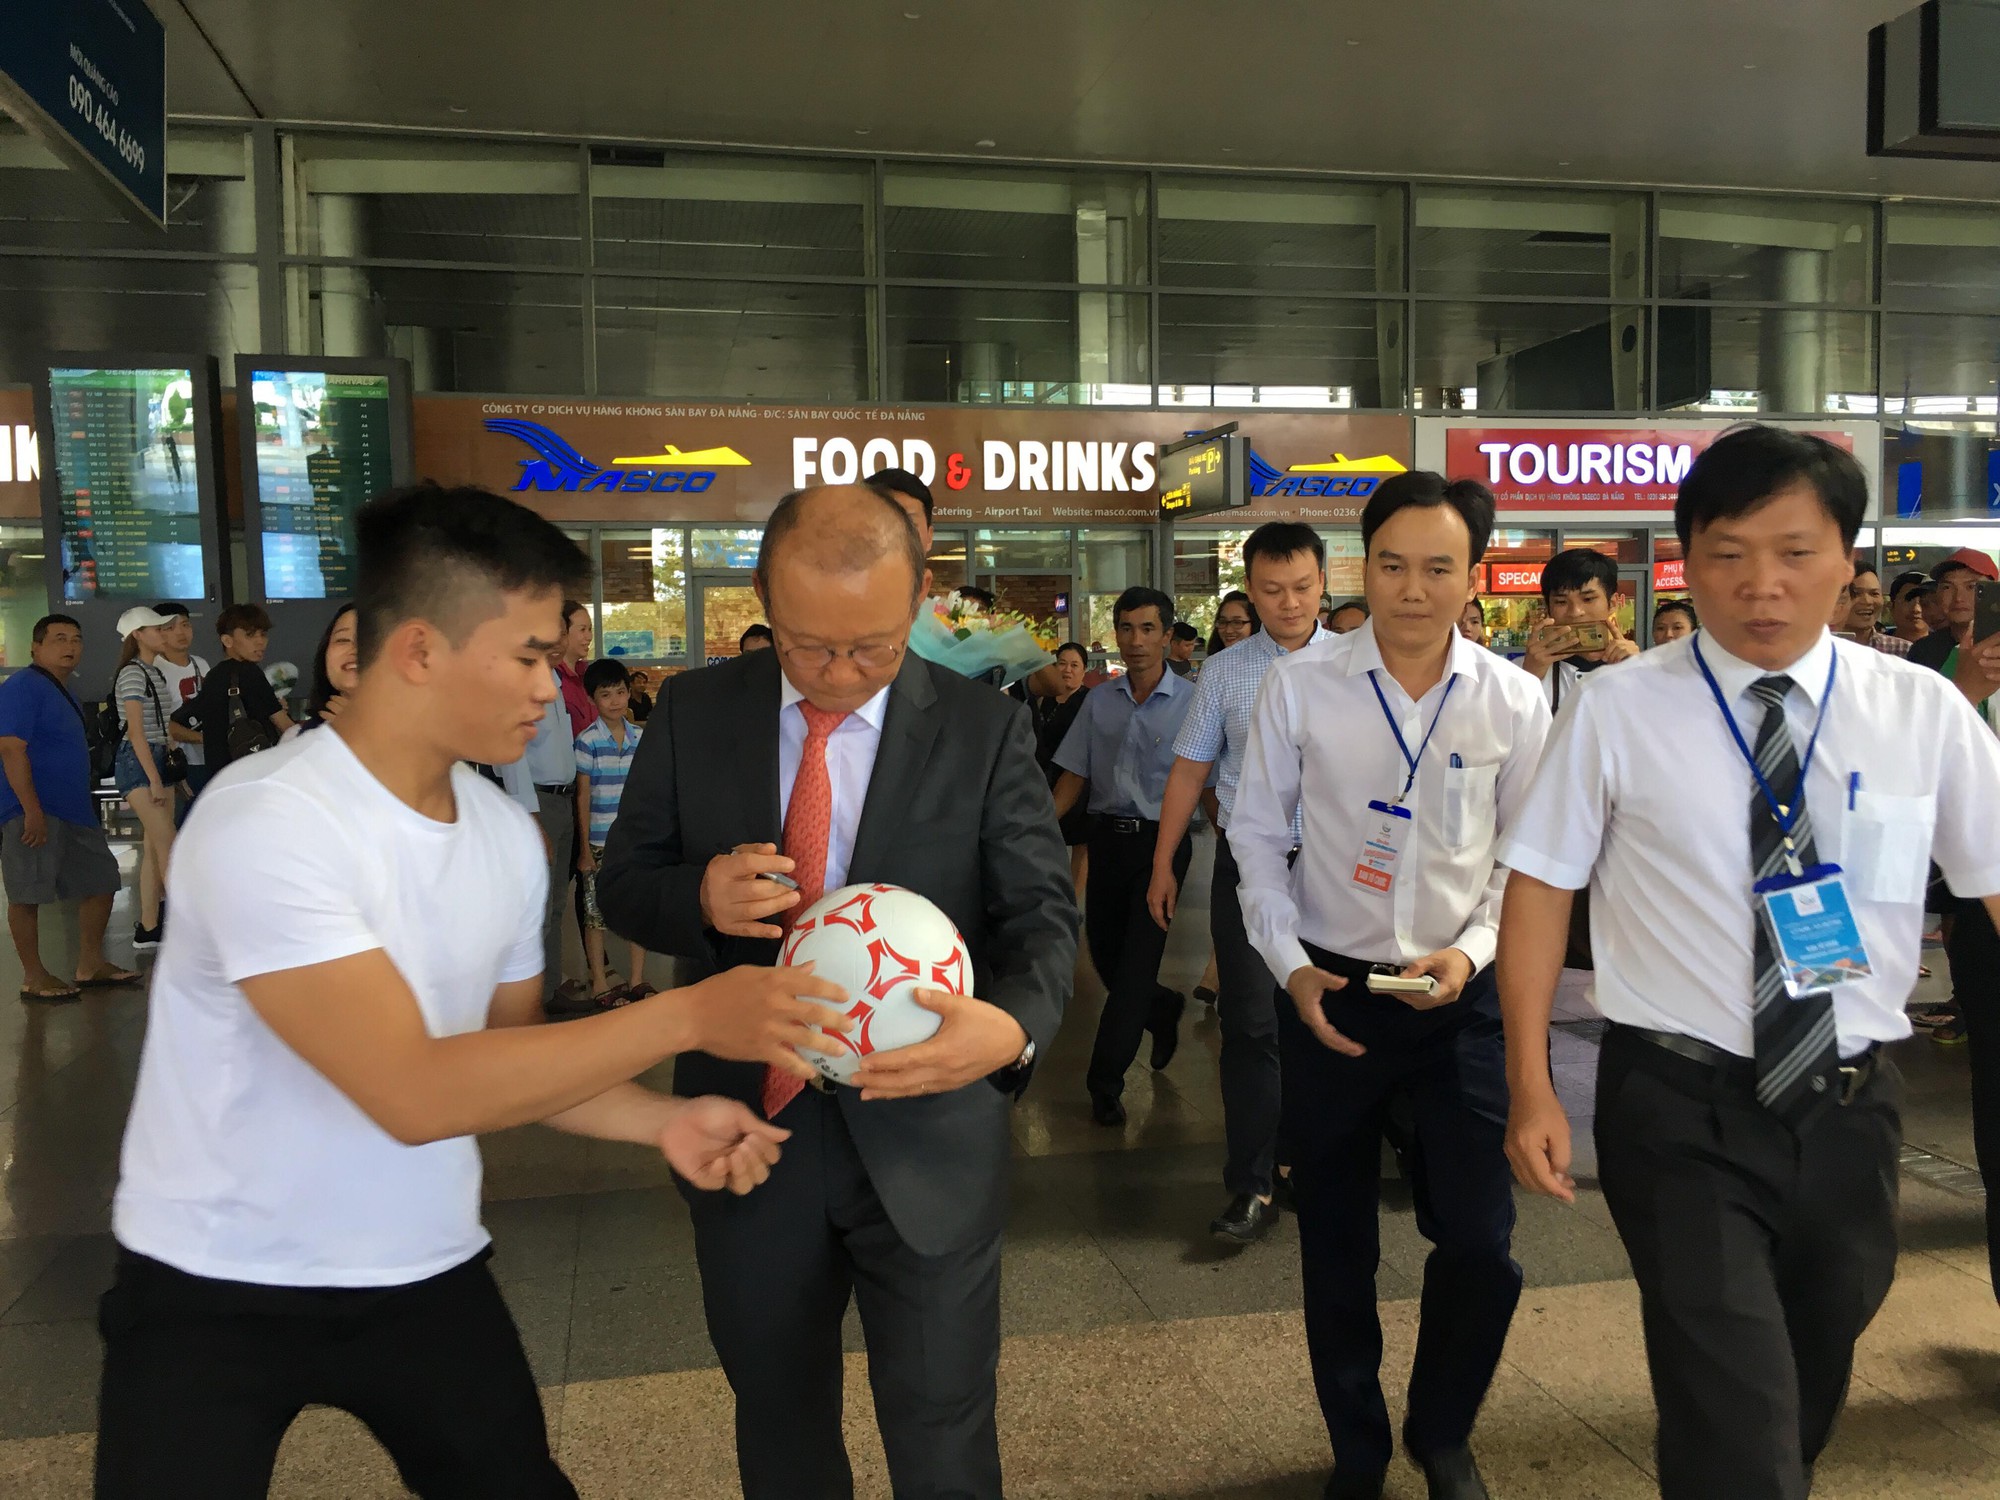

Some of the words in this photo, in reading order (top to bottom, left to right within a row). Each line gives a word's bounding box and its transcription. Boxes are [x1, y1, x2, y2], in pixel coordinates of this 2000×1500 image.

[69, 74, 92, 123] 090
[95, 103, 116, 147] 464
[119, 128, 145, 175] 6699
[481, 402, 513, 414] CÔNG
[514, 404, 528, 414] TY
[531, 404, 545, 414] CP
[547, 404, 573, 416] DỊCH
[575, 405, 590, 417] VỤ
[593, 404, 622, 416] HÀNG
[688, 407, 707, 417] BAY
[810, 410, 830, 420] BAY
[832, 407, 861, 421] QUỐC
[511, 459, 716, 493] MASCO
[793, 437, 936, 490] FOOD
[946, 453, 972, 491] &
[983, 440, 1156, 492] DRINKS
[1478, 443, 1693, 485] TOURISM
[931, 506, 972, 519] Catering
[984, 506, 1020, 519] Airport
[1022, 506, 1042, 517] Taxi
[1052, 506, 1093, 517] Website:
[1299, 507, 1333, 517] Phone:
[1663, 562, 1678, 575] PHỤ
[1655, 576, 1686, 588] ACCESS
